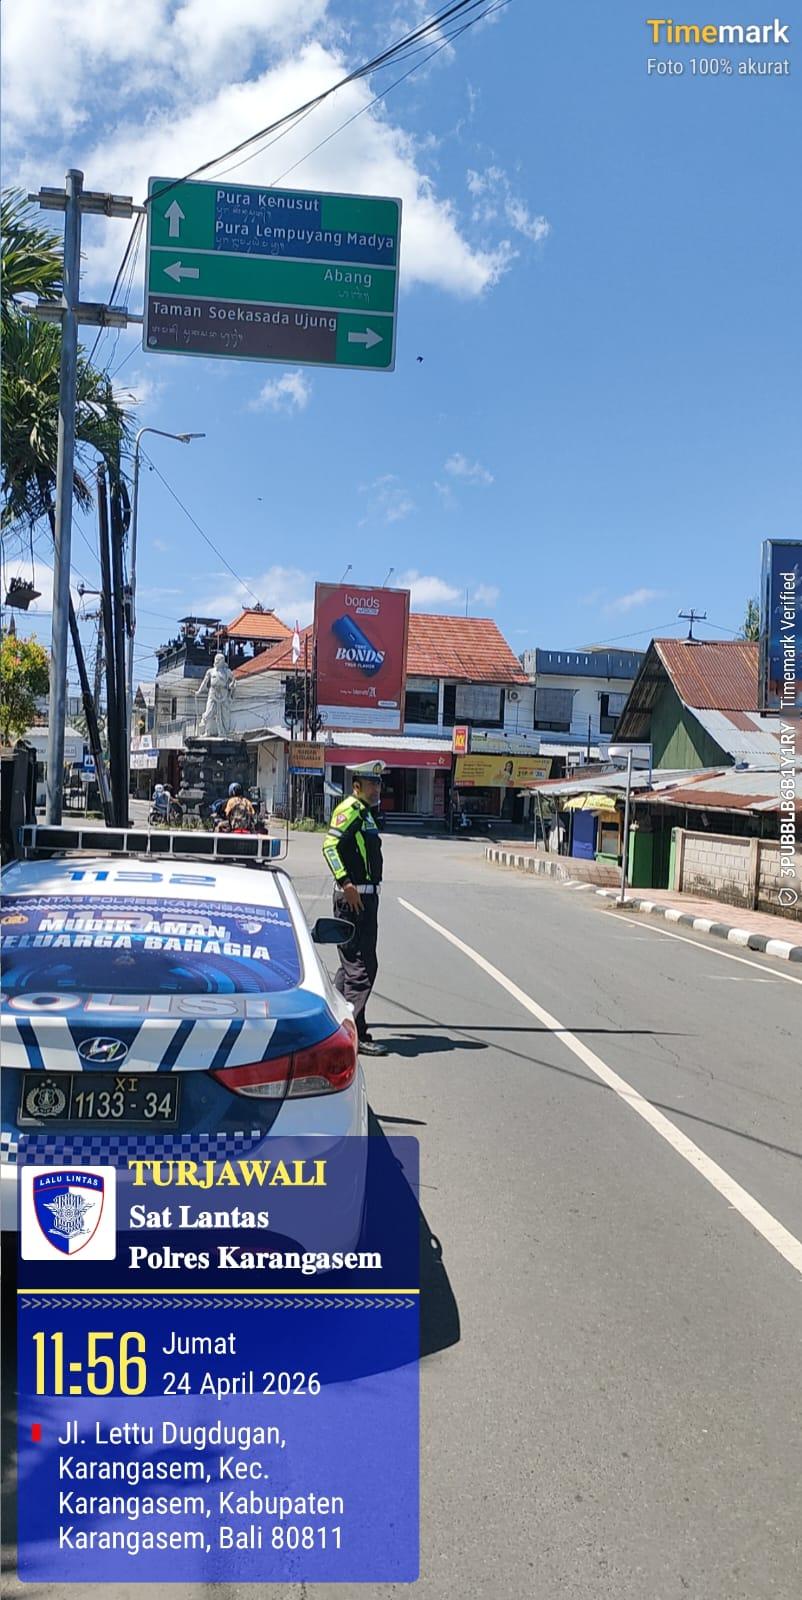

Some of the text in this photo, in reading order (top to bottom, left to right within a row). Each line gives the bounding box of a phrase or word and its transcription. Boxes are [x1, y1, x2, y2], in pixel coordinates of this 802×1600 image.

[217, 191, 320, 212] Pura Kenusut
[215, 221, 249, 236] Pura
[256, 224, 342, 247] Lempuyang
[347, 233, 394, 250] Madya
[324, 268, 372, 287] Abang
[153, 302, 337, 331] Taman Soekasada Ujung
[345, 593, 380, 608] bonds
[335, 647, 385, 664] BONDS
[65, 871, 216, 888] 1132
[89, 896, 157, 905] POLRES
[163, 899, 279, 918] KARANGASEM
[38, 919, 133, 932] MUDIK
[0, 934, 271, 960] ELUARGA BAHAGIA
[0, 992, 270, 1019] OLISI
[115, 1078, 138, 1091] XI
[75, 1091, 124, 1118] 1133
[143, 1092, 172, 1118] 34
